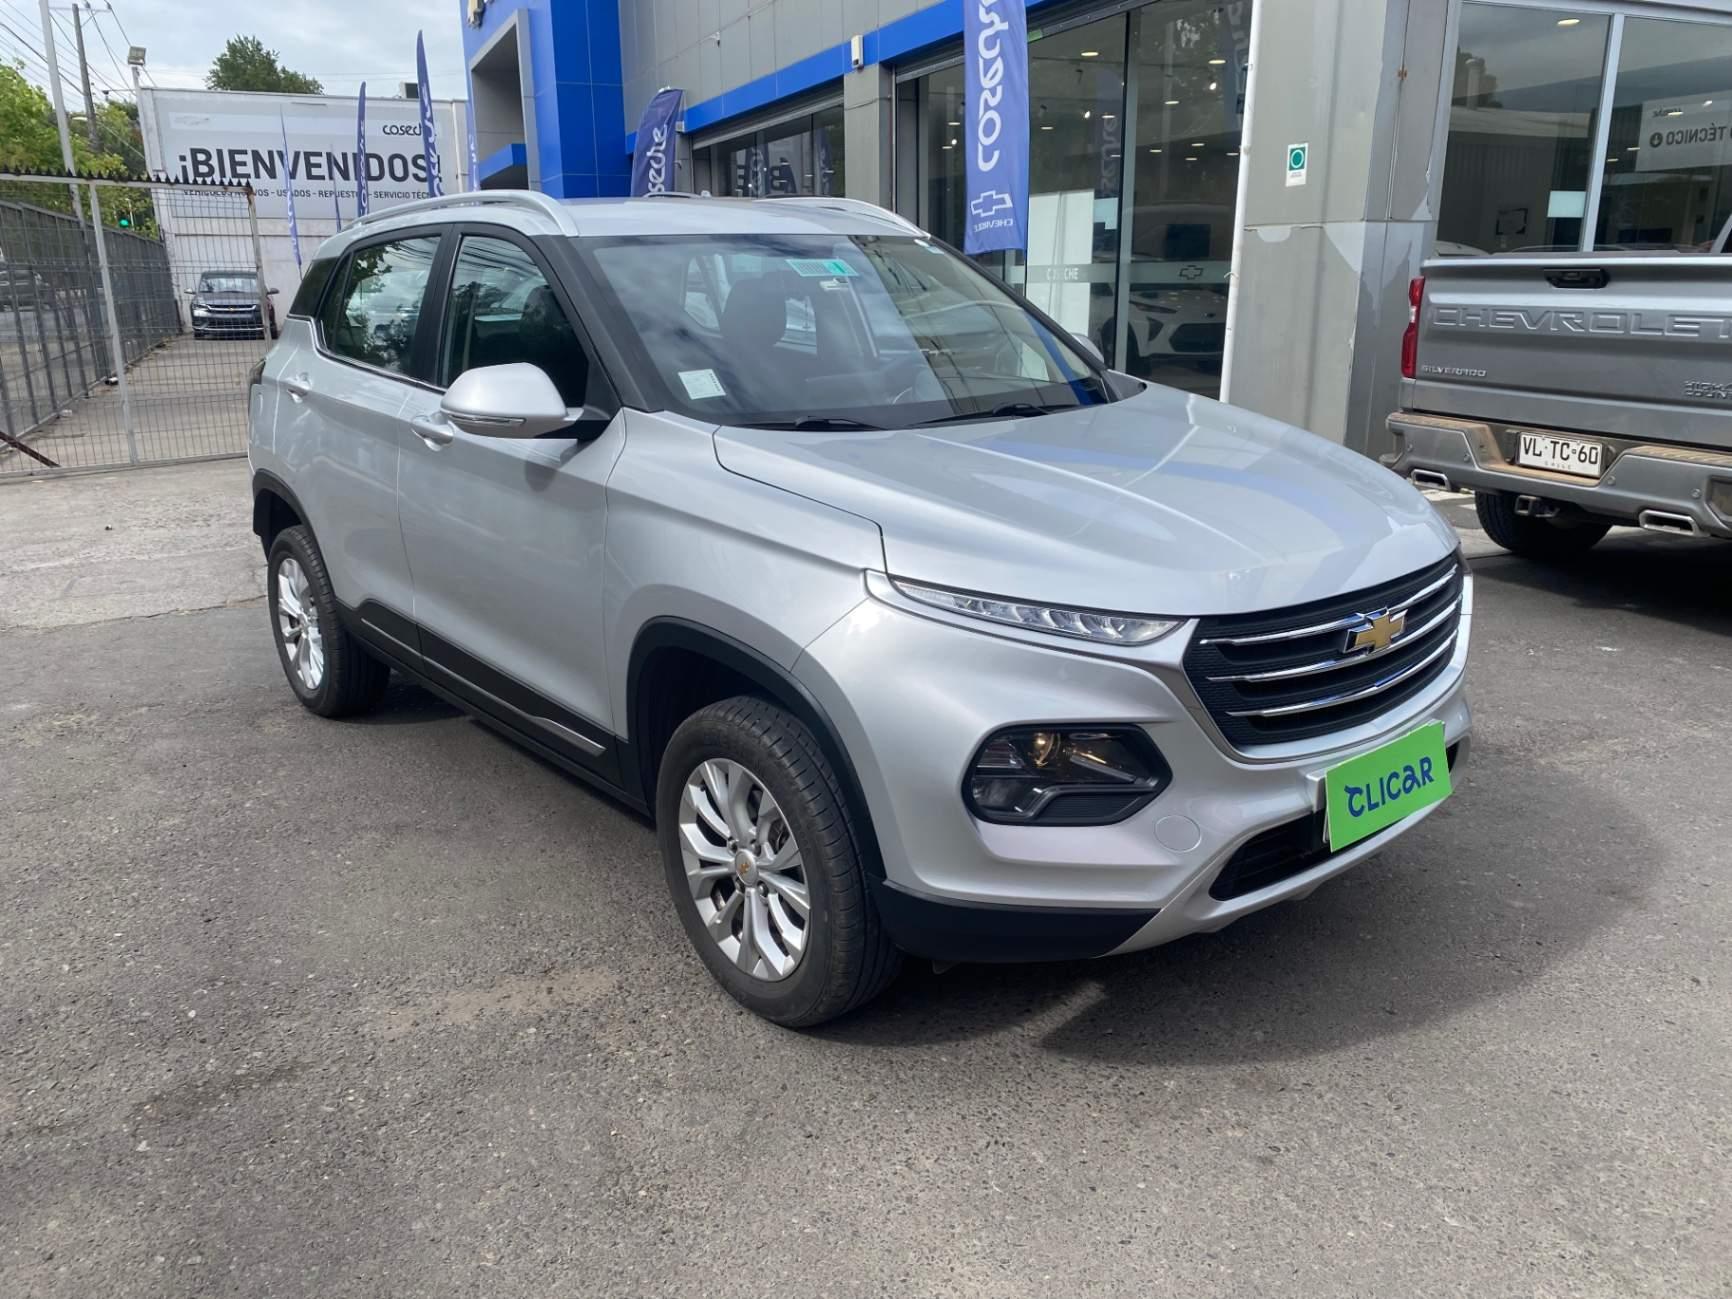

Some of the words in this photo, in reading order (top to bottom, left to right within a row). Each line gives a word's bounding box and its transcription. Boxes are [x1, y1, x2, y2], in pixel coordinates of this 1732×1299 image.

[382, 122, 437, 136] cosec
[277, 189, 312, 198] USDOS
[318, 190, 359, 199] REPUEST
[374, 191, 411, 200] SERVICIO
[412, 190, 430, 200] TÉC
[1432, 307, 1732, 338] CHEVROLET
